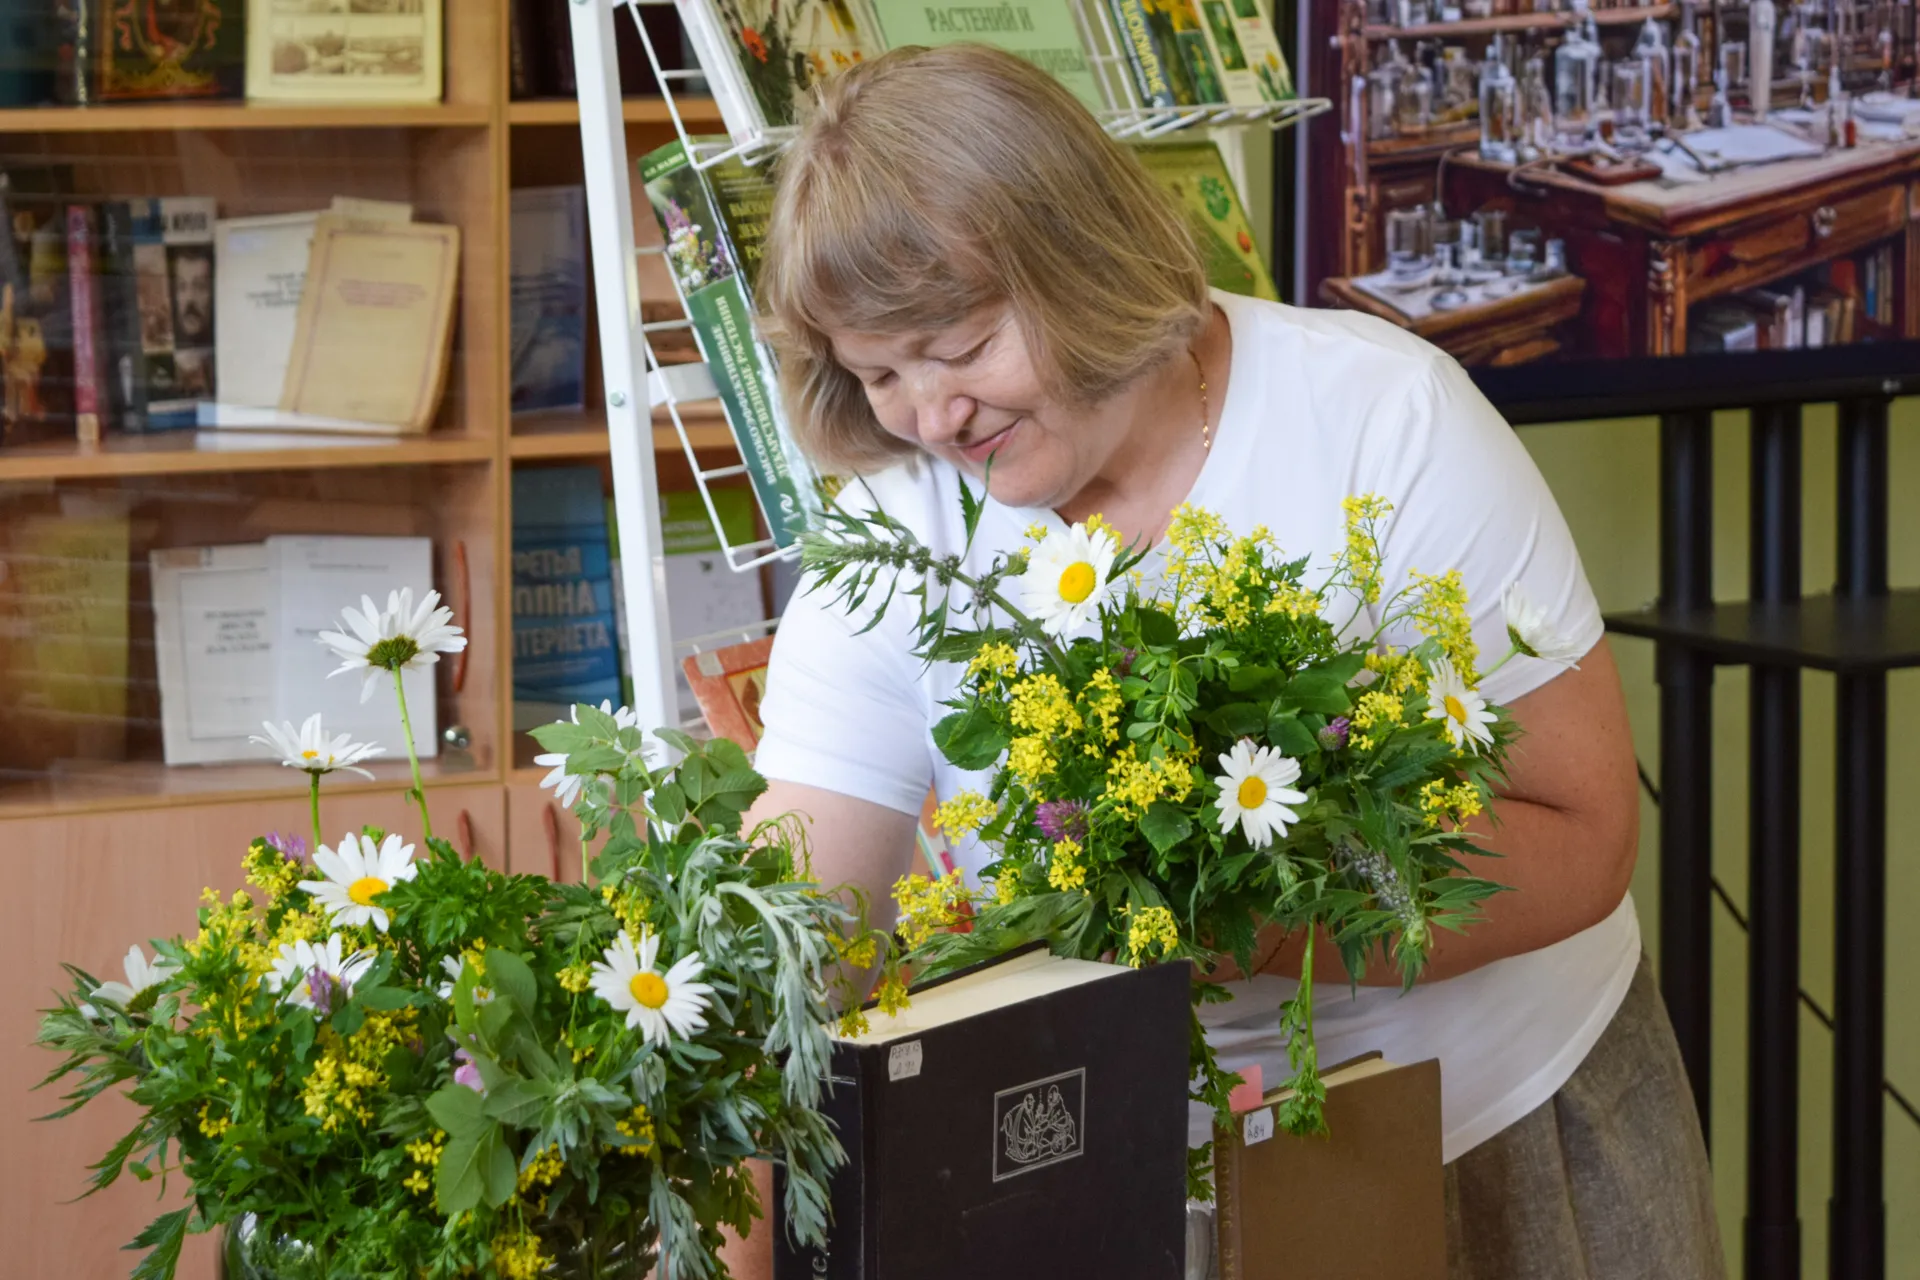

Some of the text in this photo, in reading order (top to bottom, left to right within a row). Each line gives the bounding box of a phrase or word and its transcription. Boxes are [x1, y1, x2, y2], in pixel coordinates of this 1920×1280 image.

[924, 1, 1035, 32] РАСТЕНИЙ И
[711, 323, 775, 485] ВЫСОКОЭФФЕКТИВНЫЕ
[715, 295, 789, 478] ЛЕКАРСТВЕННЫЕ РАСТЕНИЯ
[513, 546, 582, 577] РЕТЬЯ
